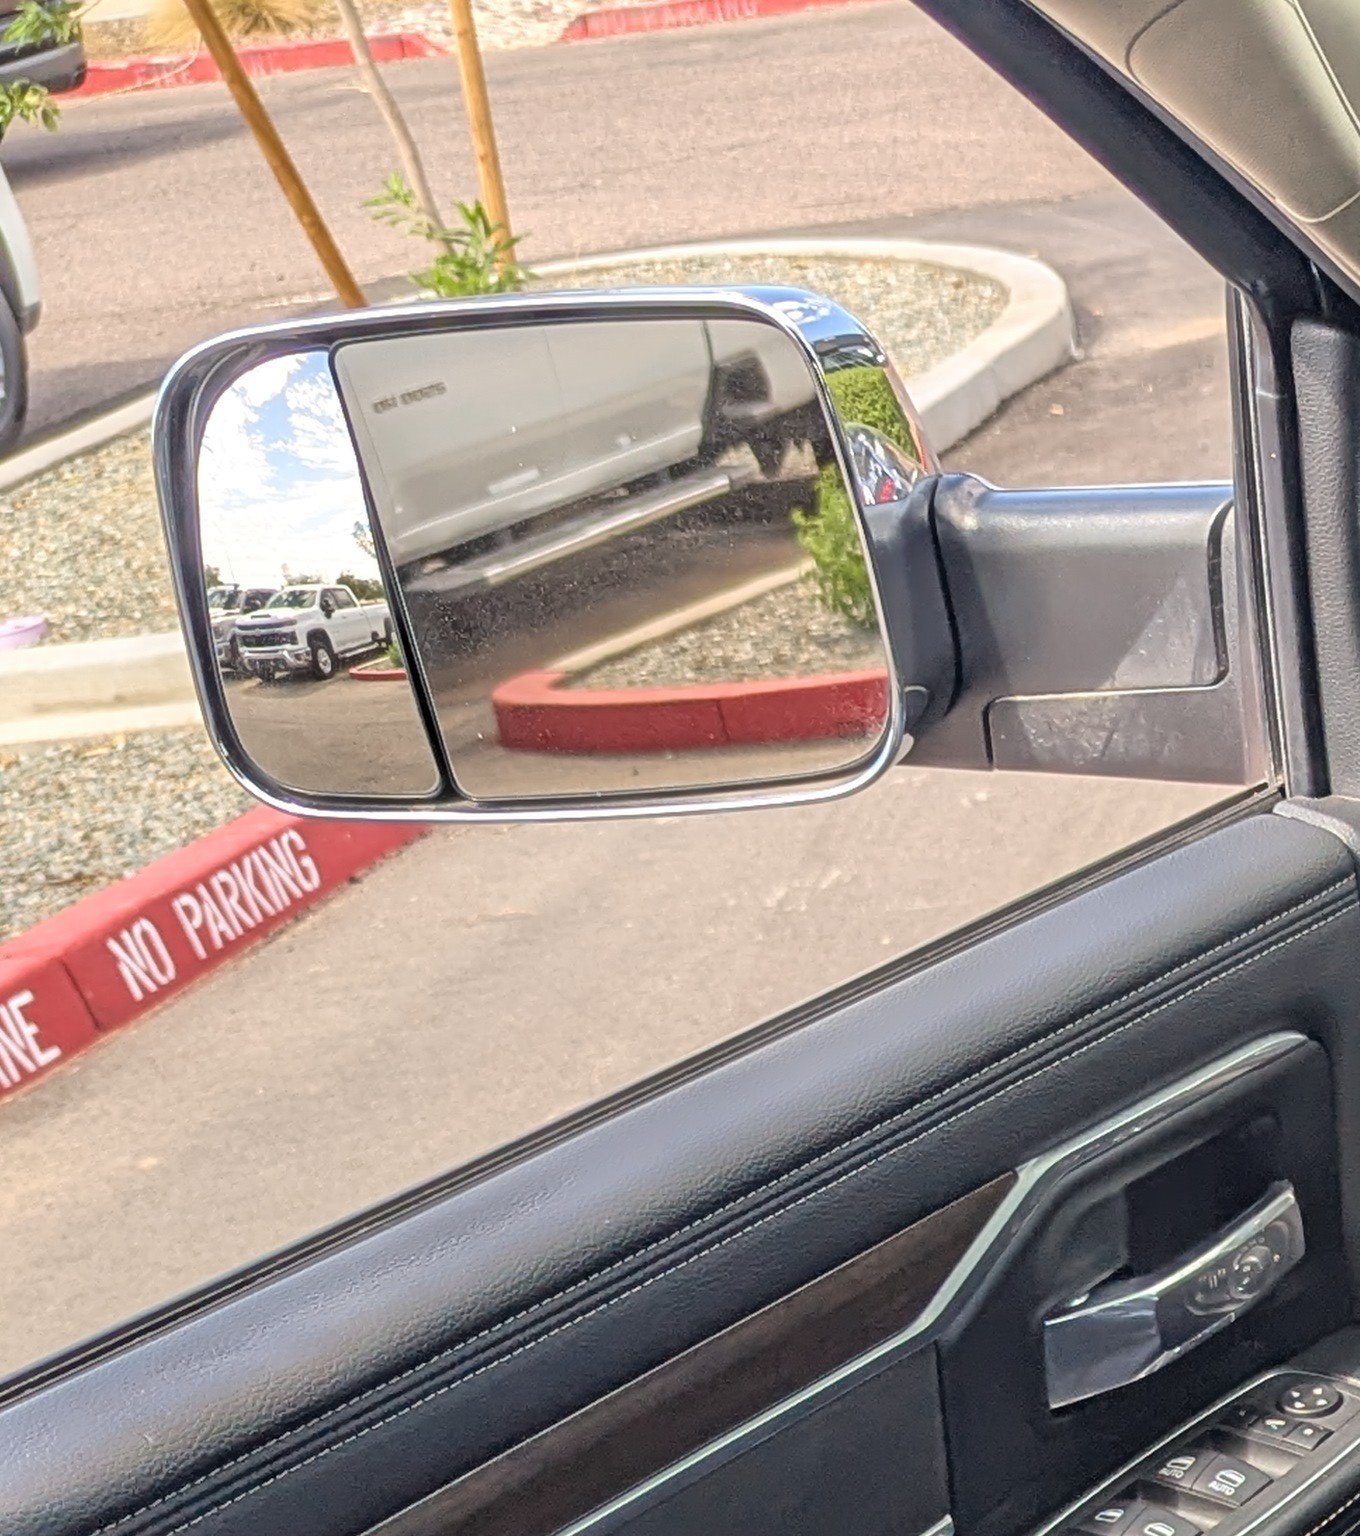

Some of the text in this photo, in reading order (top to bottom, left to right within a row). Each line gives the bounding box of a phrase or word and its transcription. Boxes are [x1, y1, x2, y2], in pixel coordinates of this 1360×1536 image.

[106, 829, 321, 1001] NO PARKING
[1158, 1467, 1185, 1479] AUTO
[1208, 1481, 1235, 1496] AUTO
